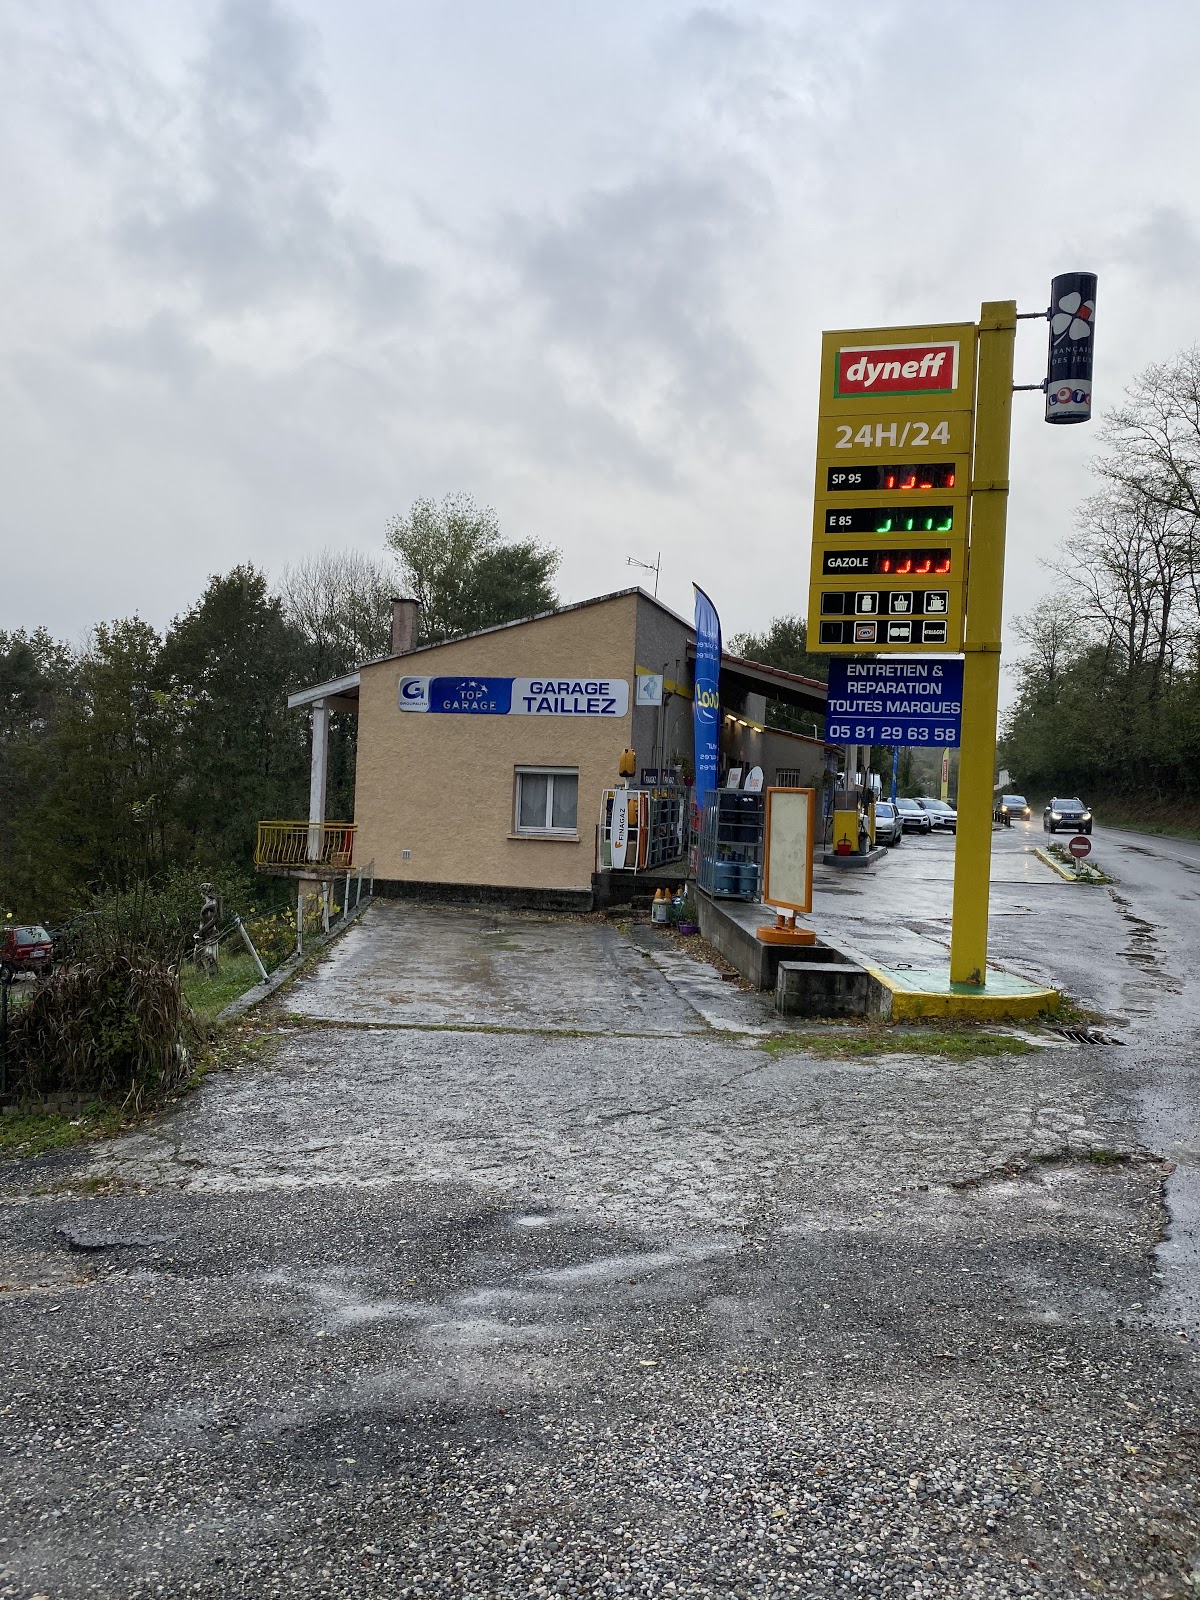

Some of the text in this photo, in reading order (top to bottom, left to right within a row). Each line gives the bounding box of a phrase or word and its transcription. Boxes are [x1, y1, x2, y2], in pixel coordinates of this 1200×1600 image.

[1052, 357, 1068, 365] DES
[846, 352, 947, 387] dyneff
[835, 421, 950, 449] 24H/24
[832, 473, 862, 484] SP 95
[829, 516, 852, 526] E 85
[827, 557, 868, 567] GAZOLE
[846, 664, 943, 677] ENTRETIEN &
[530, 681, 610, 695] GARAGE
[847, 682, 942, 694] REPARATION
[459, 691, 483, 700] TOP
[443, 700, 496, 710] GARAGE
[522, 697, 617, 714] TAILLEZ
[828, 700, 960, 714] TOUTES MARQUES
[829, 726, 956, 741] 05 81 29 63 58
[618, 808, 626, 841] FINAGAZ
